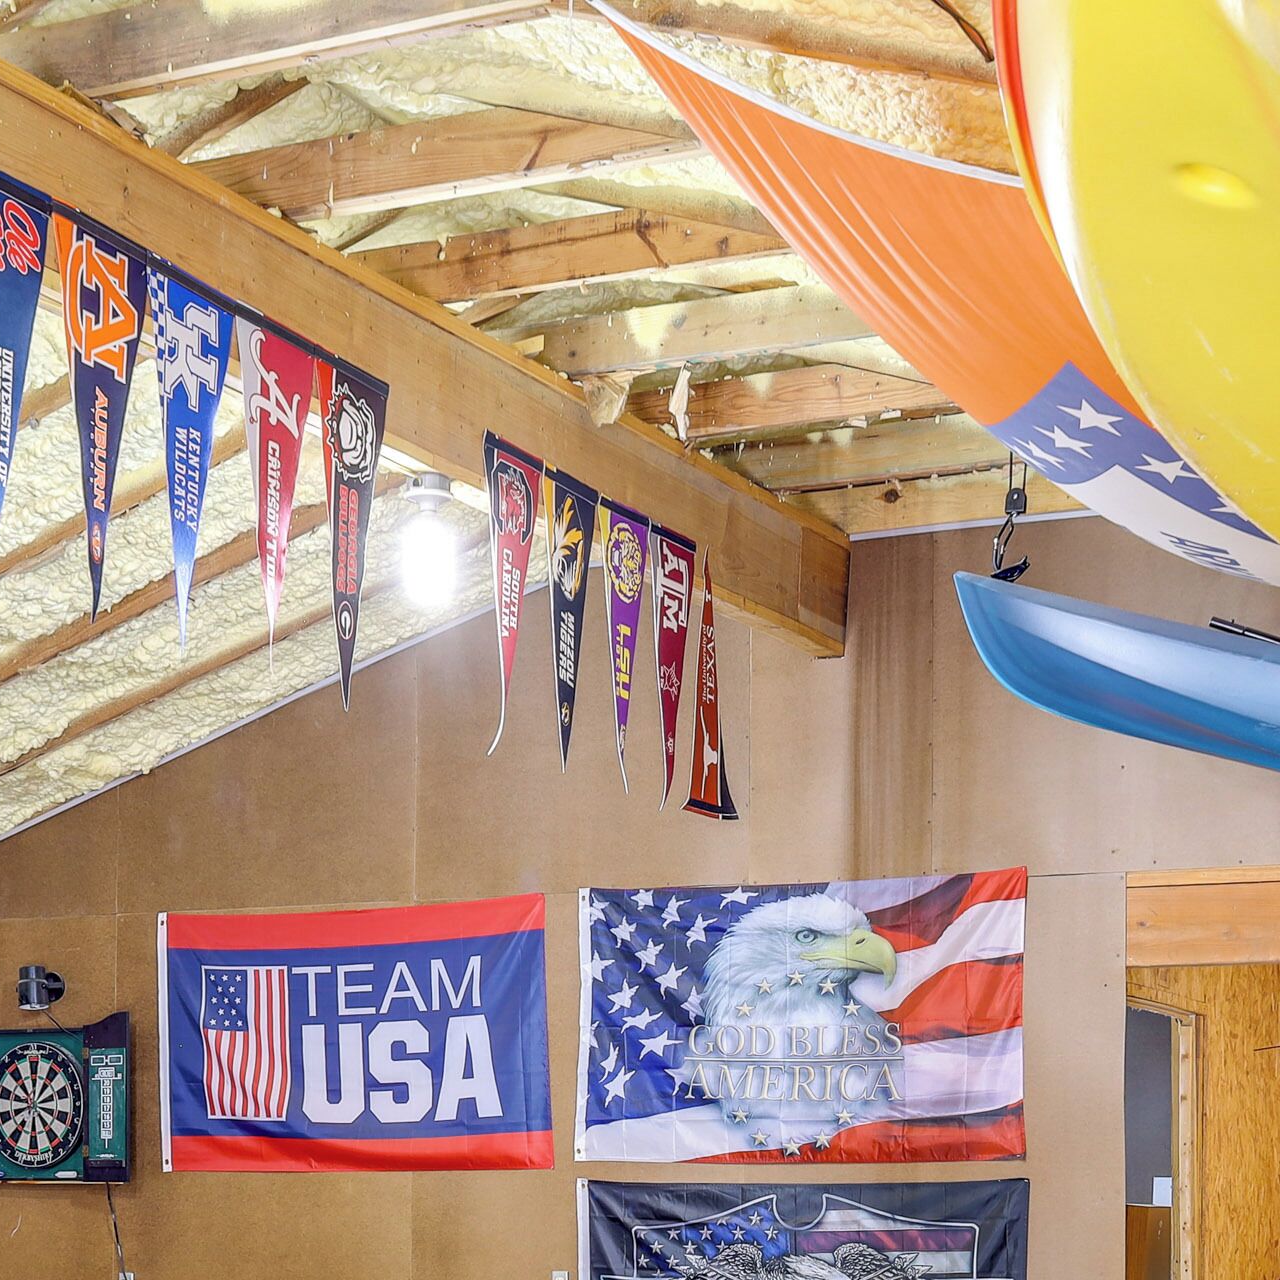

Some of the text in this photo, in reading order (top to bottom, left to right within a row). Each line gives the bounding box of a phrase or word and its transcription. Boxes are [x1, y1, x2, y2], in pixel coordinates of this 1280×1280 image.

[3, 199, 41, 275] Ole
[66, 233, 139, 385] AU
[164, 301, 220, 414] UK
[248, 327, 301, 441] A
[92, 385, 109, 513] AUBURN
[173, 425, 188, 523] WILDCATS
[186, 426, 201, 534] KENTUCKY
[266, 439, 281, 538] CRIMSON
[335, 483, 350, 594] BULLDOGS
[345, 487, 359, 595] GEORGIA
[500, 547, 514, 638] CAROLINA
[508, 566, 521, 631] SOUTH
[558, 610, 568, 683] TIGERS
[565, 610, 575, 689] MIZZOU
[618, 623, 632, 701] LSU
[705, 625, 716, 704] TEXAS
[291, 955, 483, 1018] TEAM
[300, 1013, 505, 1125] USA
[683, 1061, 905, 1102] AMERICA
[687, 1021, 904, 1058] GOD BLESS
